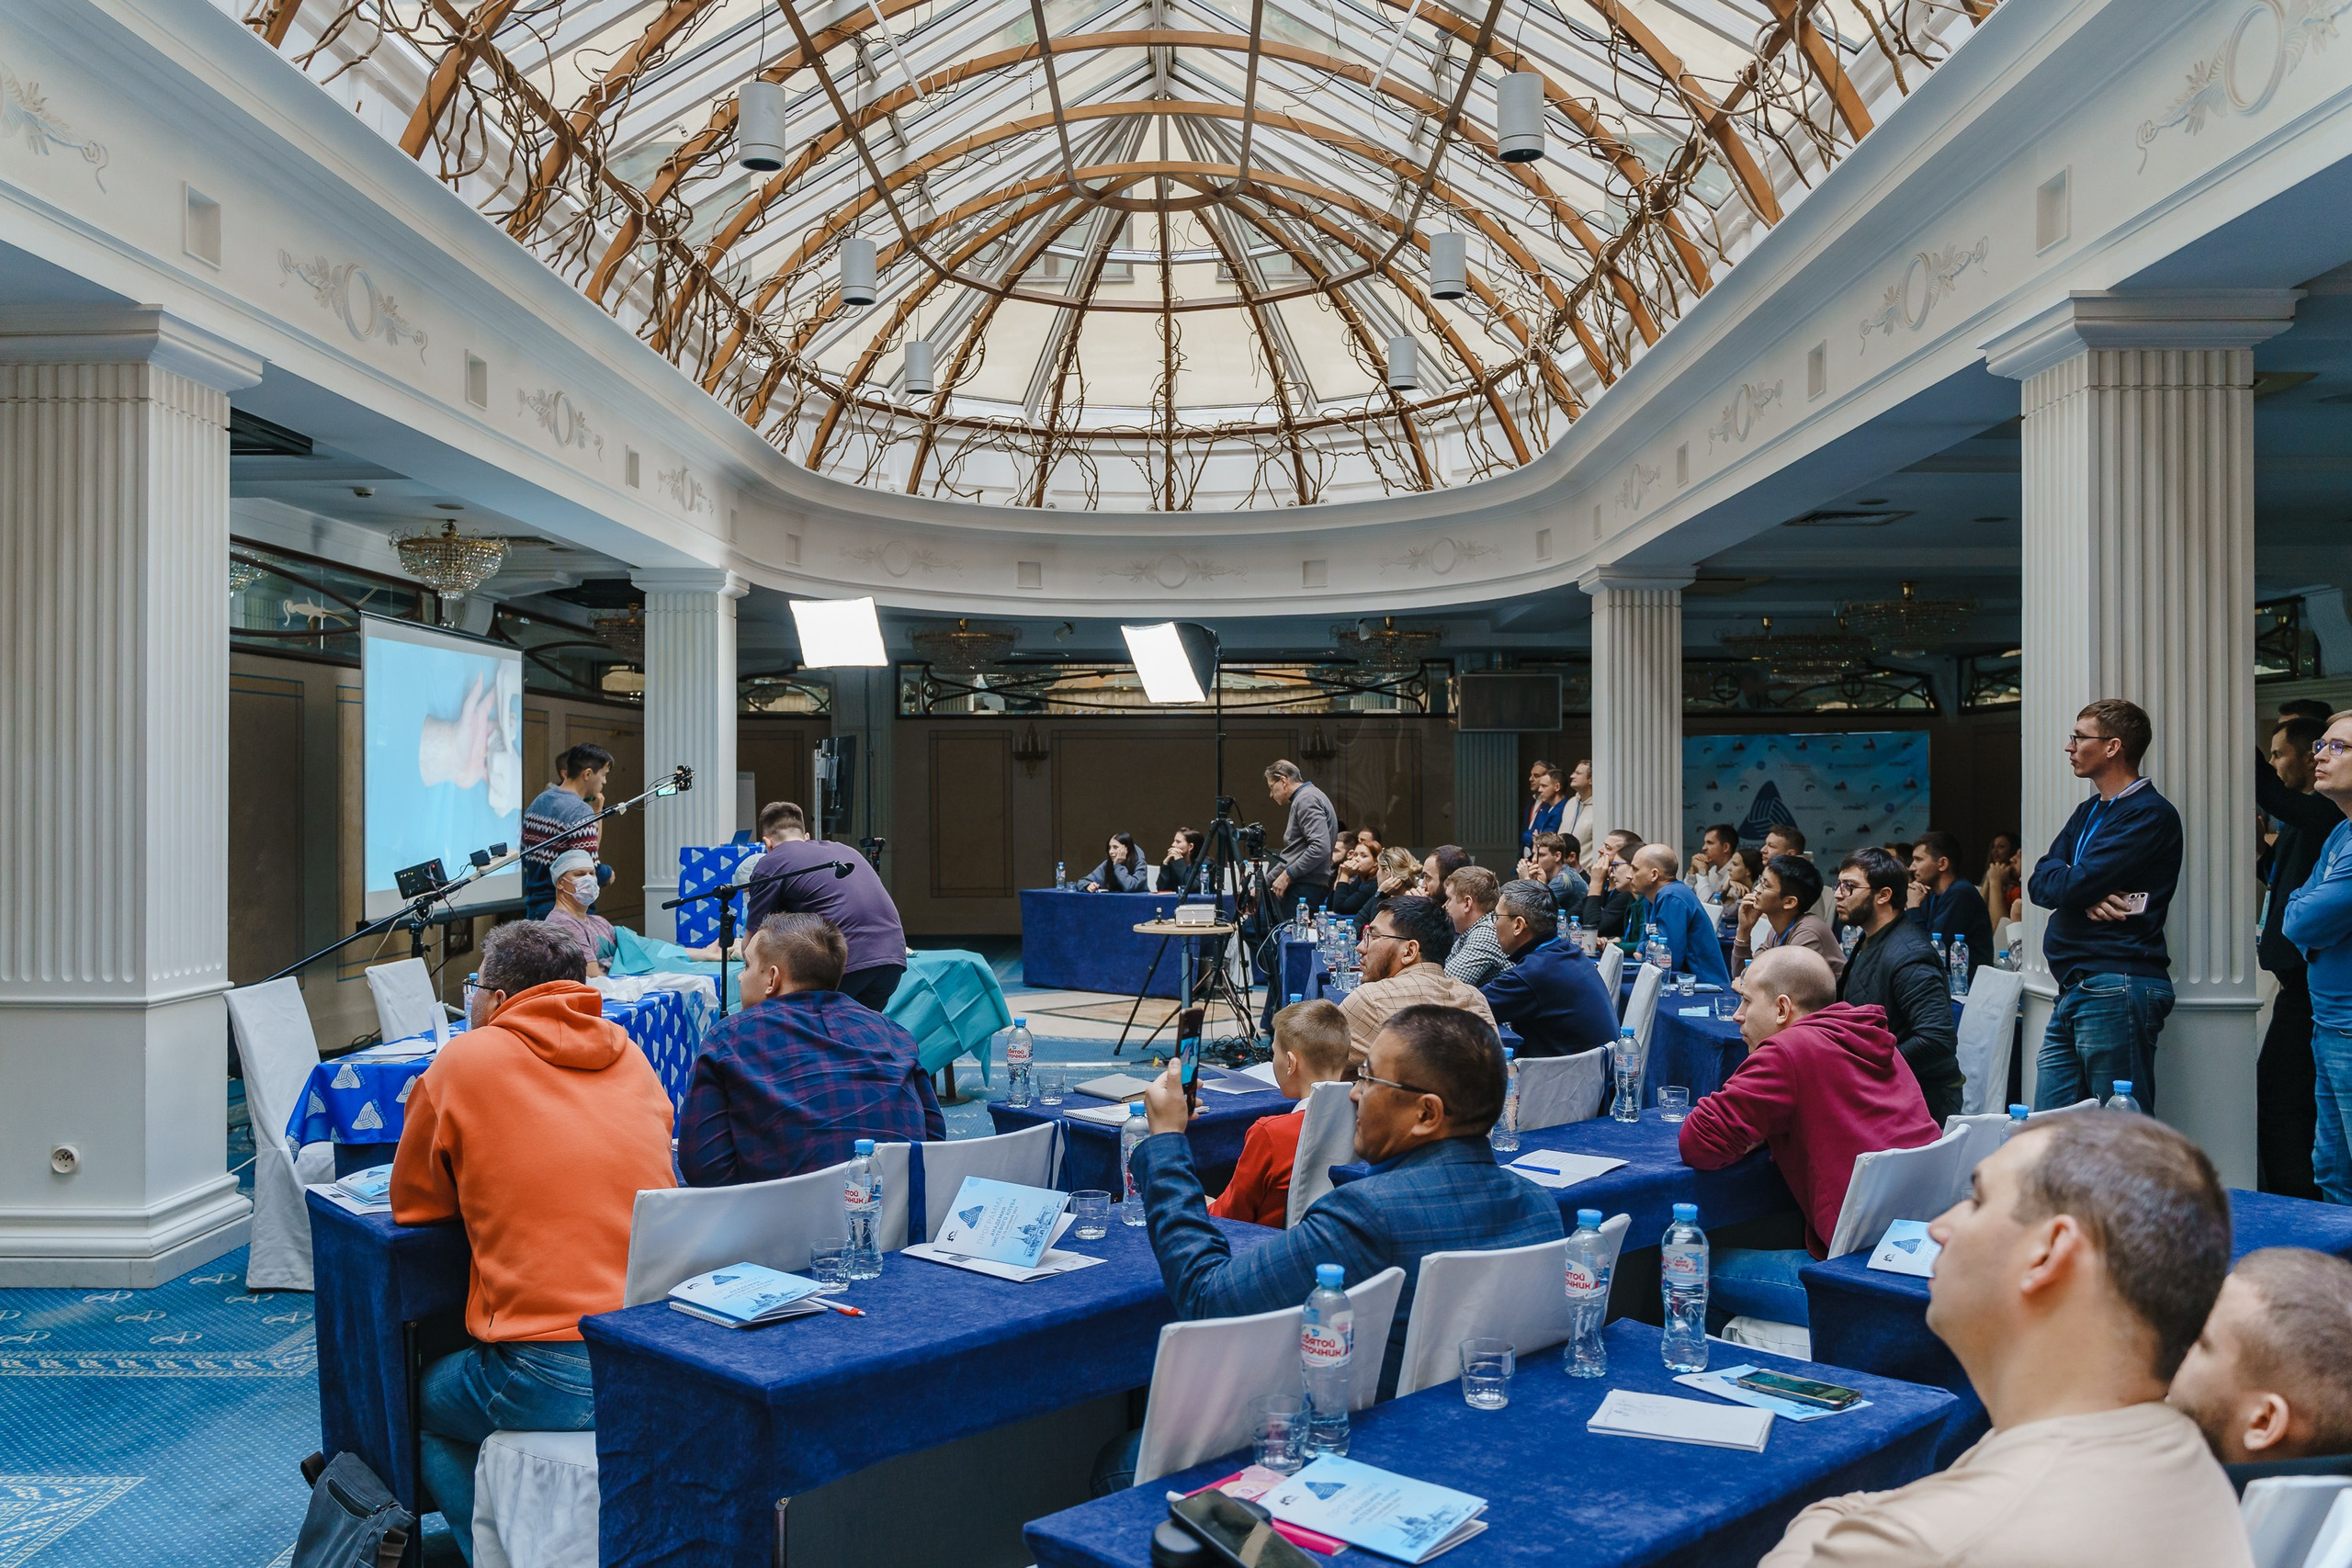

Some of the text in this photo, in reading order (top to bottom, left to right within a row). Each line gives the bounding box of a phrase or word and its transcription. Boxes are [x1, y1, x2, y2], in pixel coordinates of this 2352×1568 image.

[977, 1196, 1004, 1245] ПРОГРАММА
[990, 1206, 1007, 1236] АКАДЕМИЯ
[991, 1215, 1009, 1247] КИСТЕВОГО
[1005, 1198, 1017, 1215] КЛУБА
[1565, 1270, 1586, 1281] ЯТОЙ
